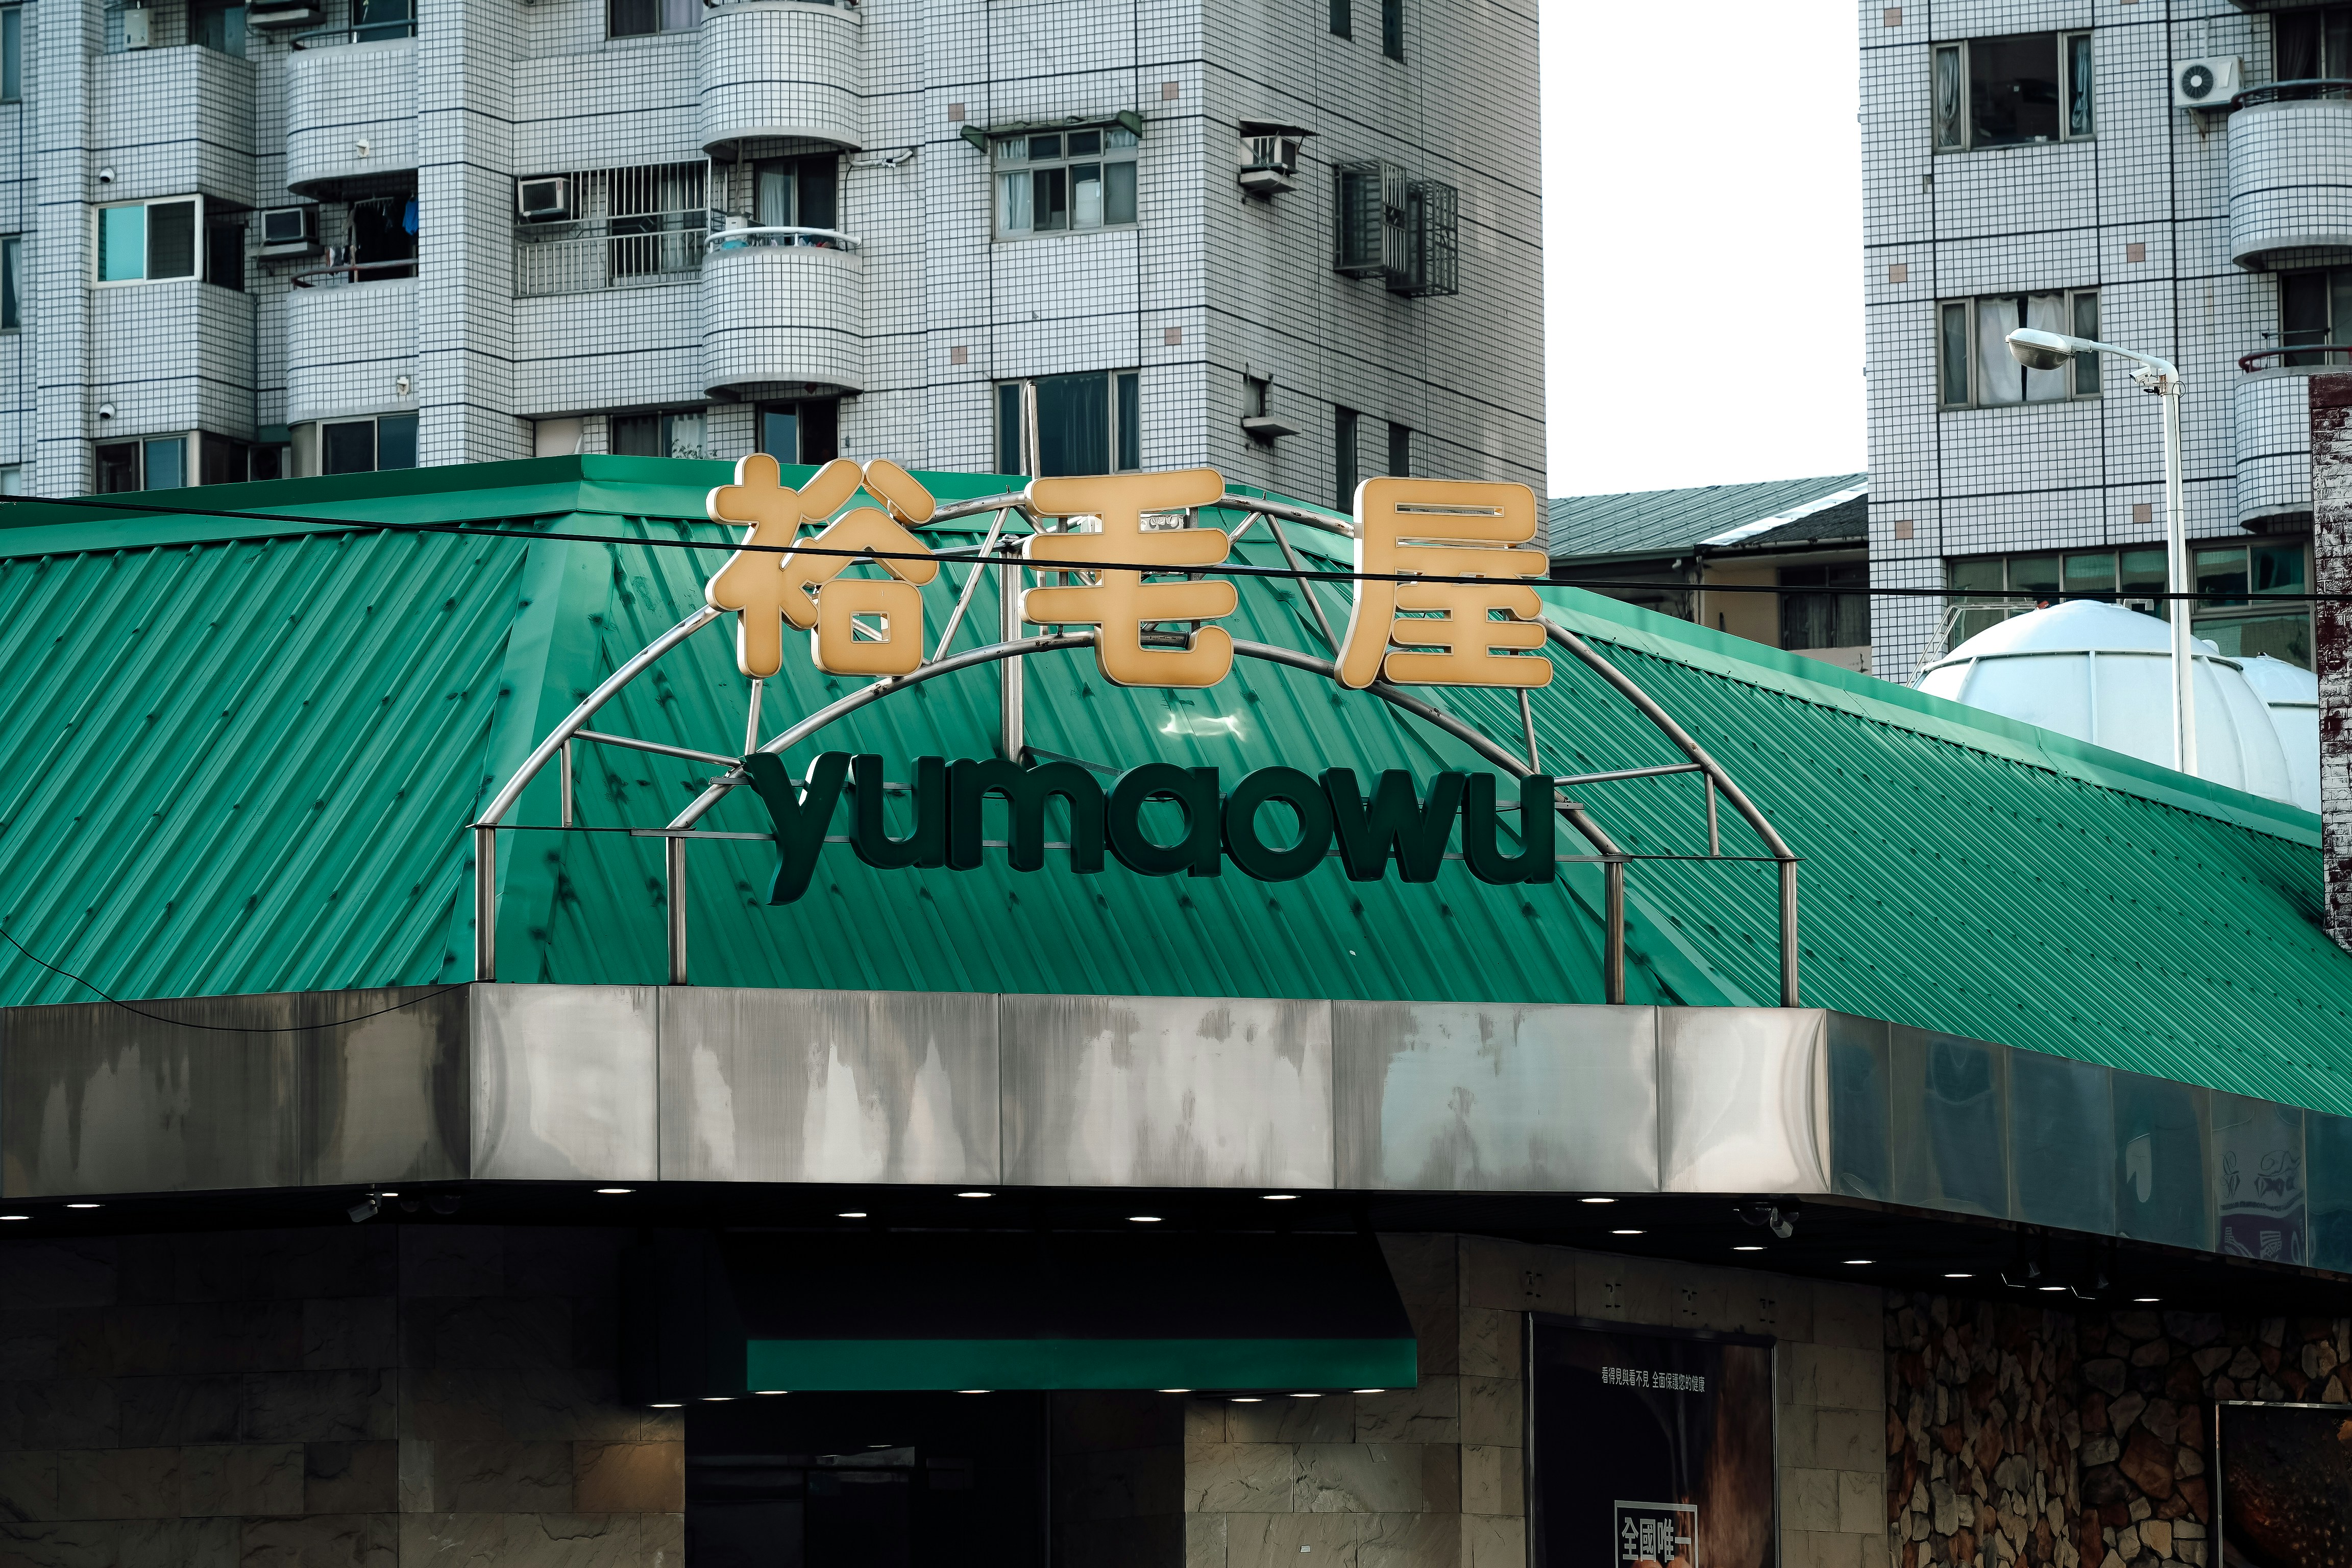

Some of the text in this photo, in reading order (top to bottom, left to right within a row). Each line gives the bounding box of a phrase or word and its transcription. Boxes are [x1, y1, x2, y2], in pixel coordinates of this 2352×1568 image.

[705, 453, 1553, 690] 裕毛屋
[744, 751, 1555, 906] yumaowu
[1602, 1367, 1705, 1392] 看得見與看不見 全面保護您的健康
[1622, 1517, 1691, 1563] 全國唯一
